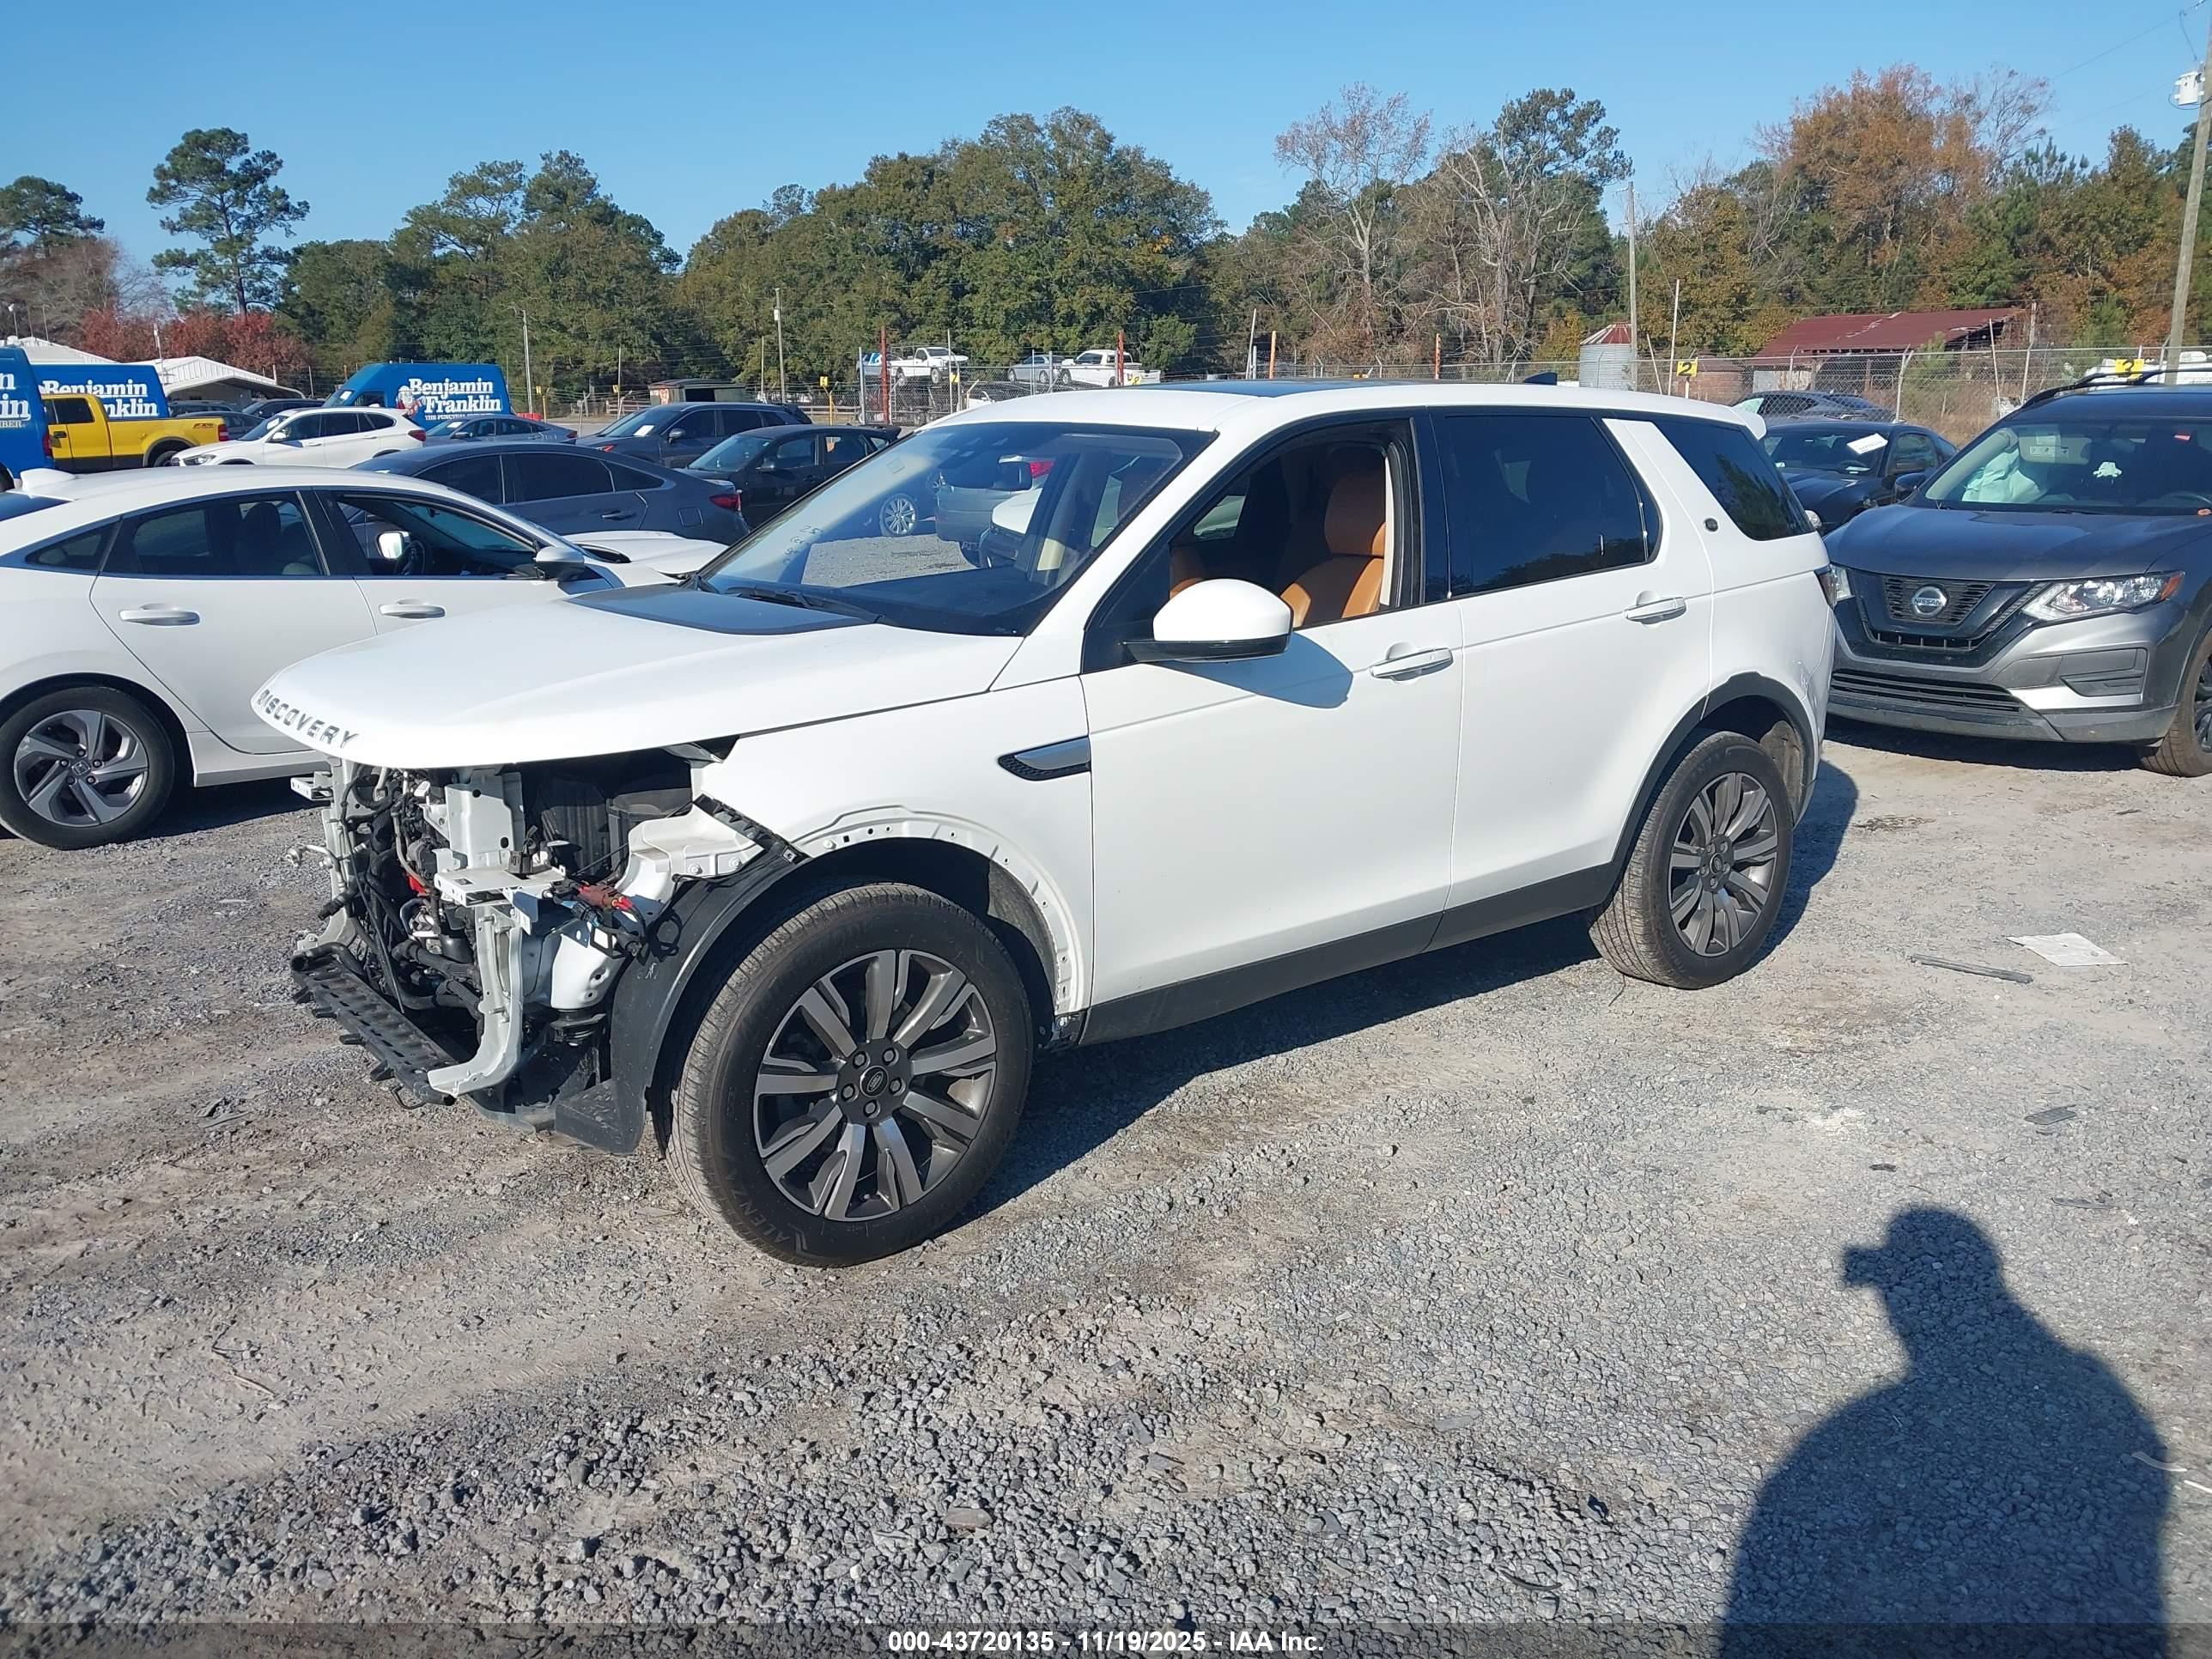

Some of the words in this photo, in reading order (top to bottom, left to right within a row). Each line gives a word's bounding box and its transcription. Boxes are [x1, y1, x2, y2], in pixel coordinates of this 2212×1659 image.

[1678, 362, 1692, 376] 2
[42, 379, 149, 398] Benjamin
[409, 378, 494, 399] Benjamin
[104, 398, 159, 418] nklin
[424, 395, 501, 413] Franklin
[1914, 598, 1942, 606] NISSAN
[256, 689, 360, 749] DISCOVERY
